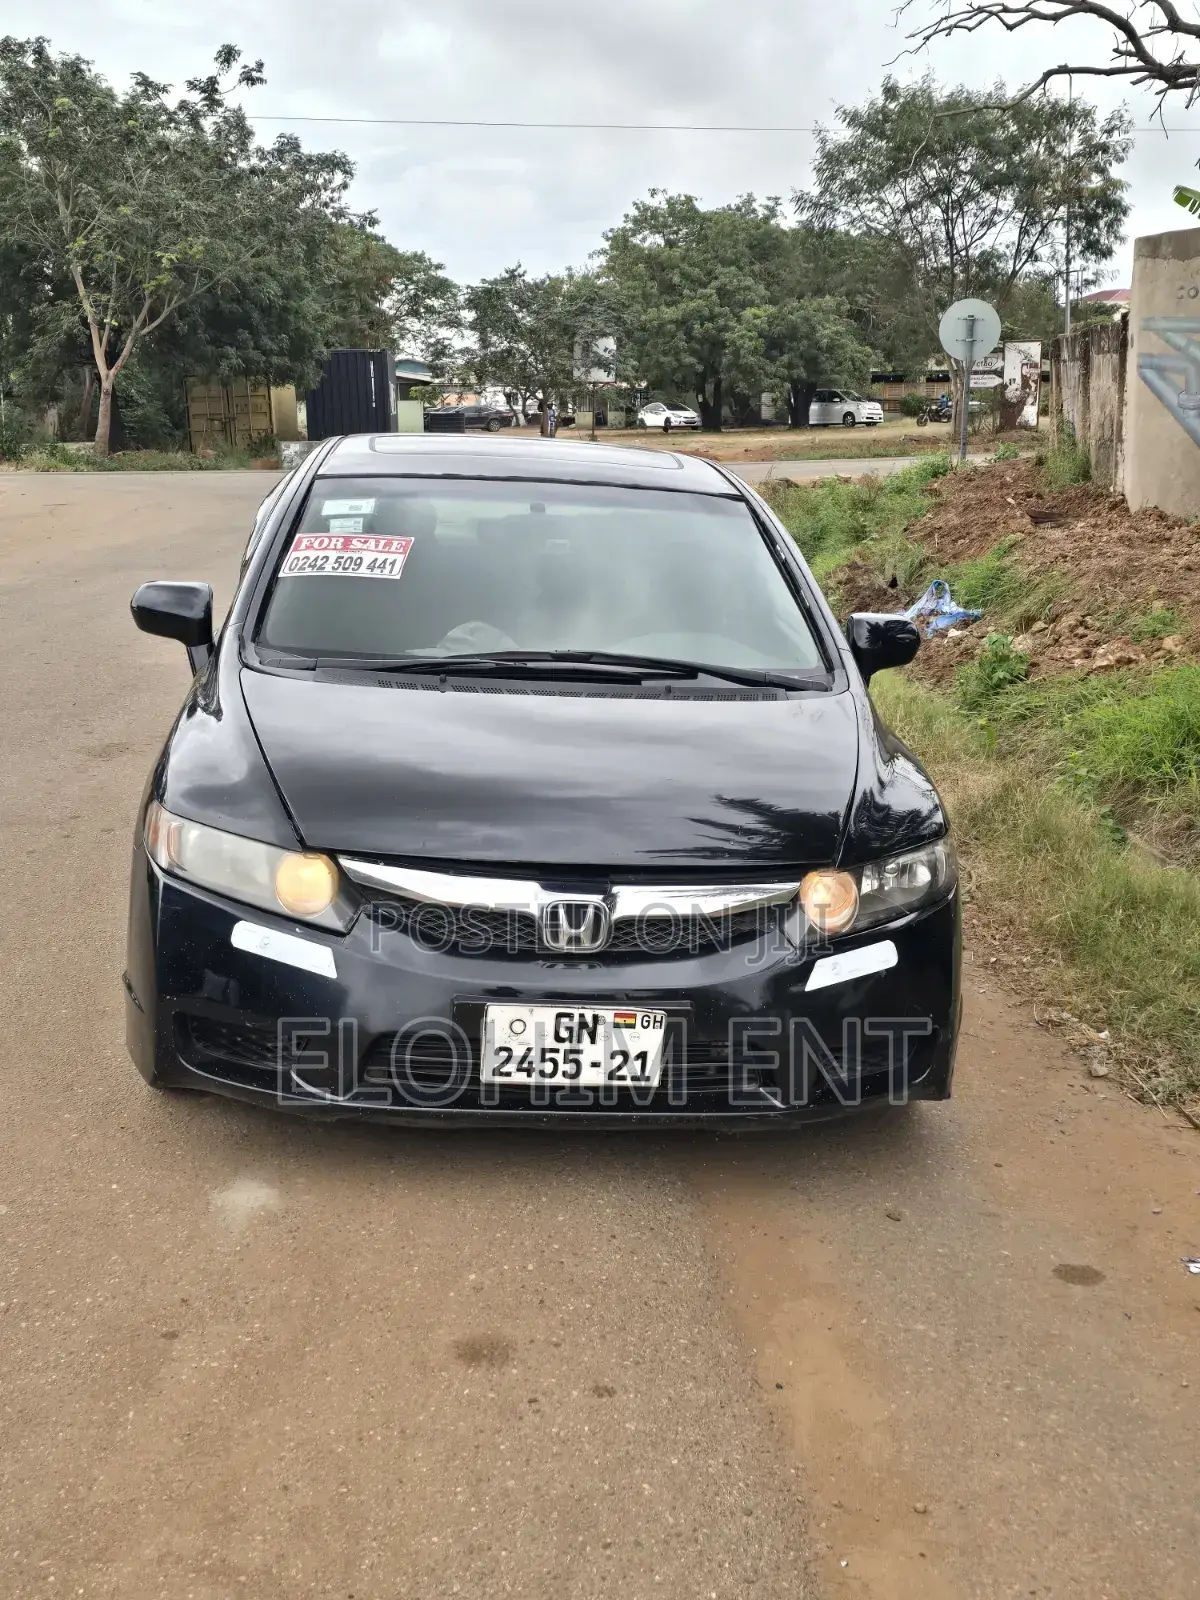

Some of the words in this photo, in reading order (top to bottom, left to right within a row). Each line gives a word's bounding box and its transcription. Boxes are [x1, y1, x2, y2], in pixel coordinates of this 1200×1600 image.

[300, 537, 344, 550] FOR
[349, 537, 406, 552] SALE
[288, 555, 330, 572] 0242
[331, 555, 363, 572] 509
[366, 557, 398, 575] 441
[554, 1012, 599, 1045] GN
[640, 1014, 664, 1030] GH
[492, 1046, 651, 1082] 2455-21
